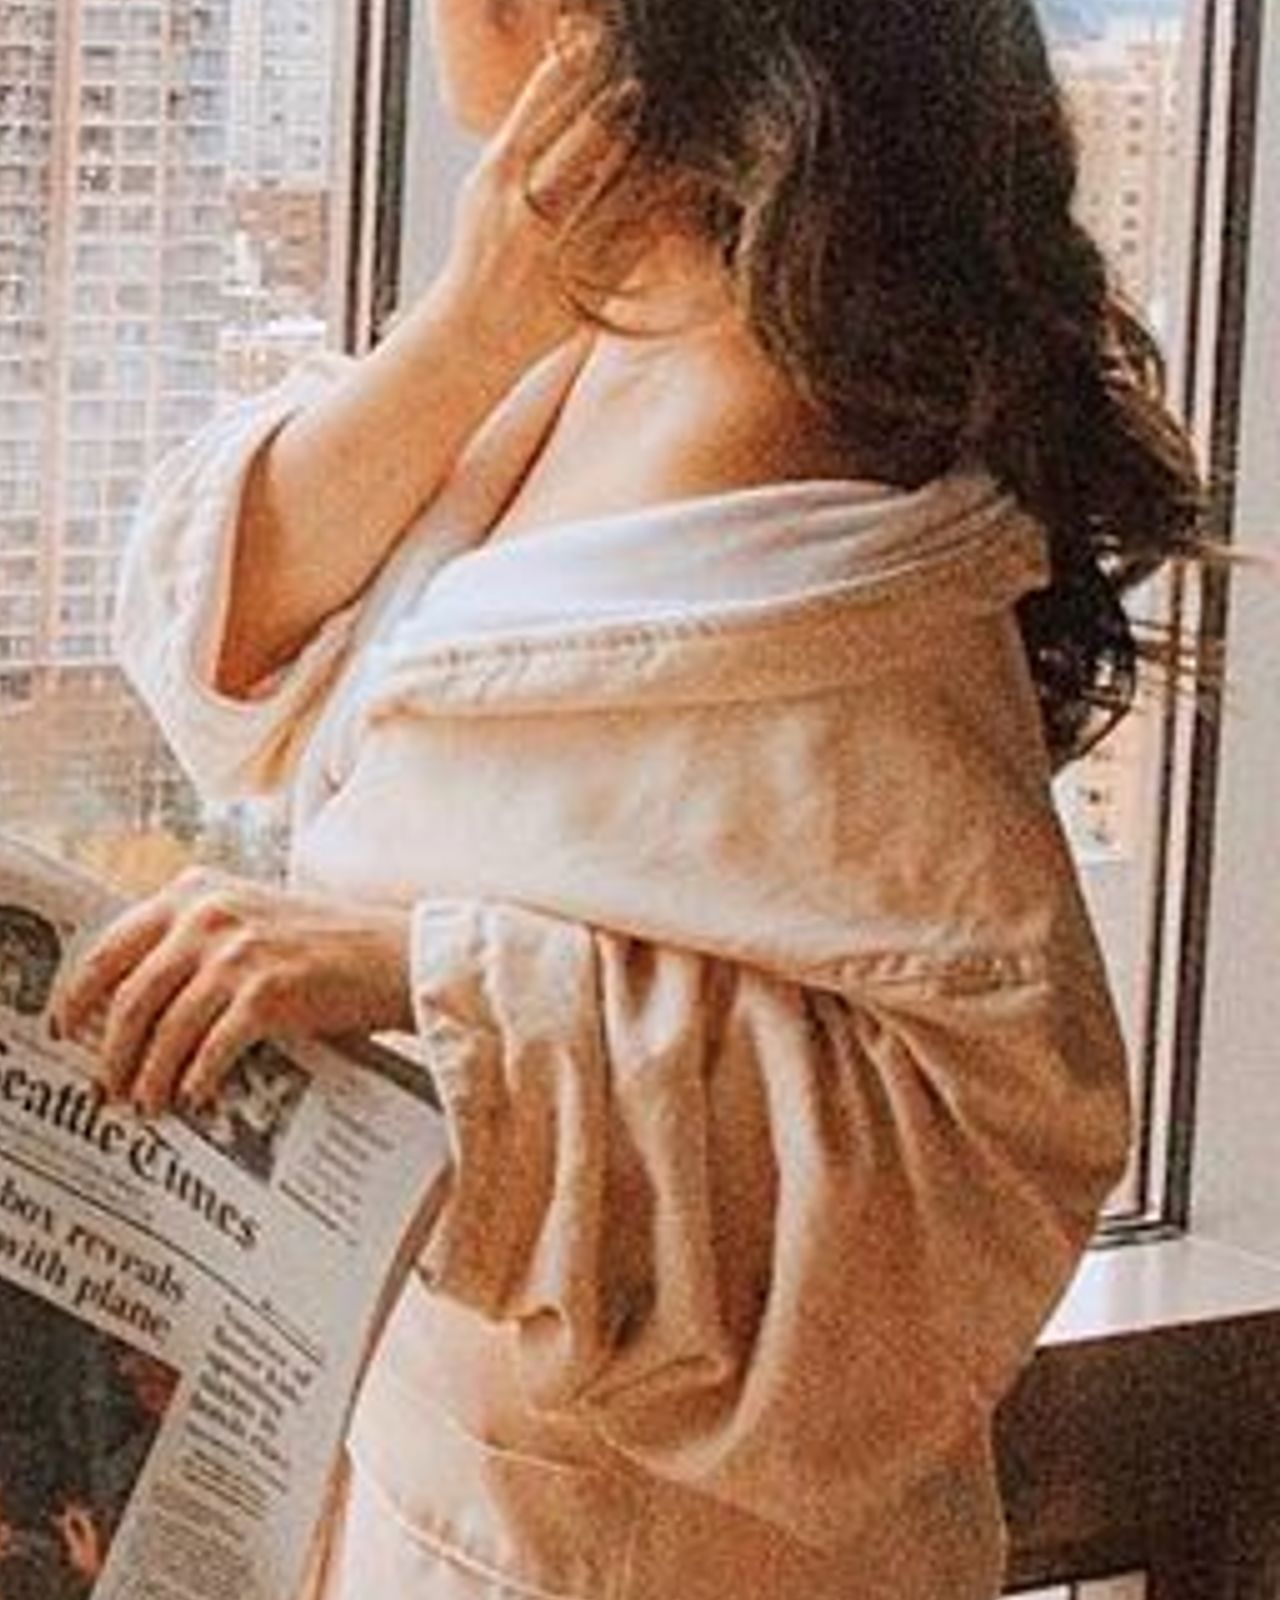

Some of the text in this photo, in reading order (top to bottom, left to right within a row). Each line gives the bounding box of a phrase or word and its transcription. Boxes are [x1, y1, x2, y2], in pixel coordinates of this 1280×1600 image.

[129, 1123, 262, 1250] Times
[64, 1218, 188, 1304] reveals
[74, 1272, 174, 1344] plane
